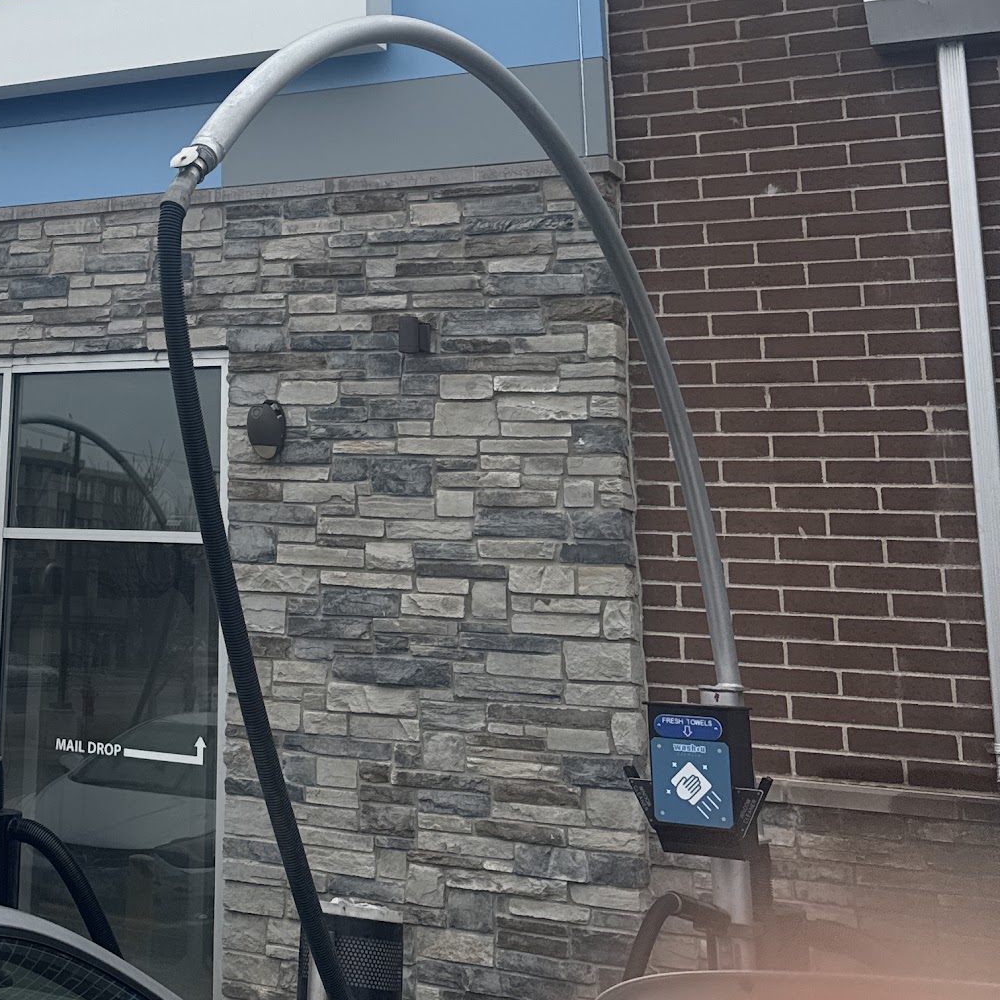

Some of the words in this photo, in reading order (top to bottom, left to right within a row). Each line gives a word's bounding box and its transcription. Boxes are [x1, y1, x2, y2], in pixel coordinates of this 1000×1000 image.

[662, 716, 684, 725] FRESH
[686, 718, 713, 728] TOWELS
[55, 738, 85, 753] MAIL
[87, 741, 122, 757] DROP
